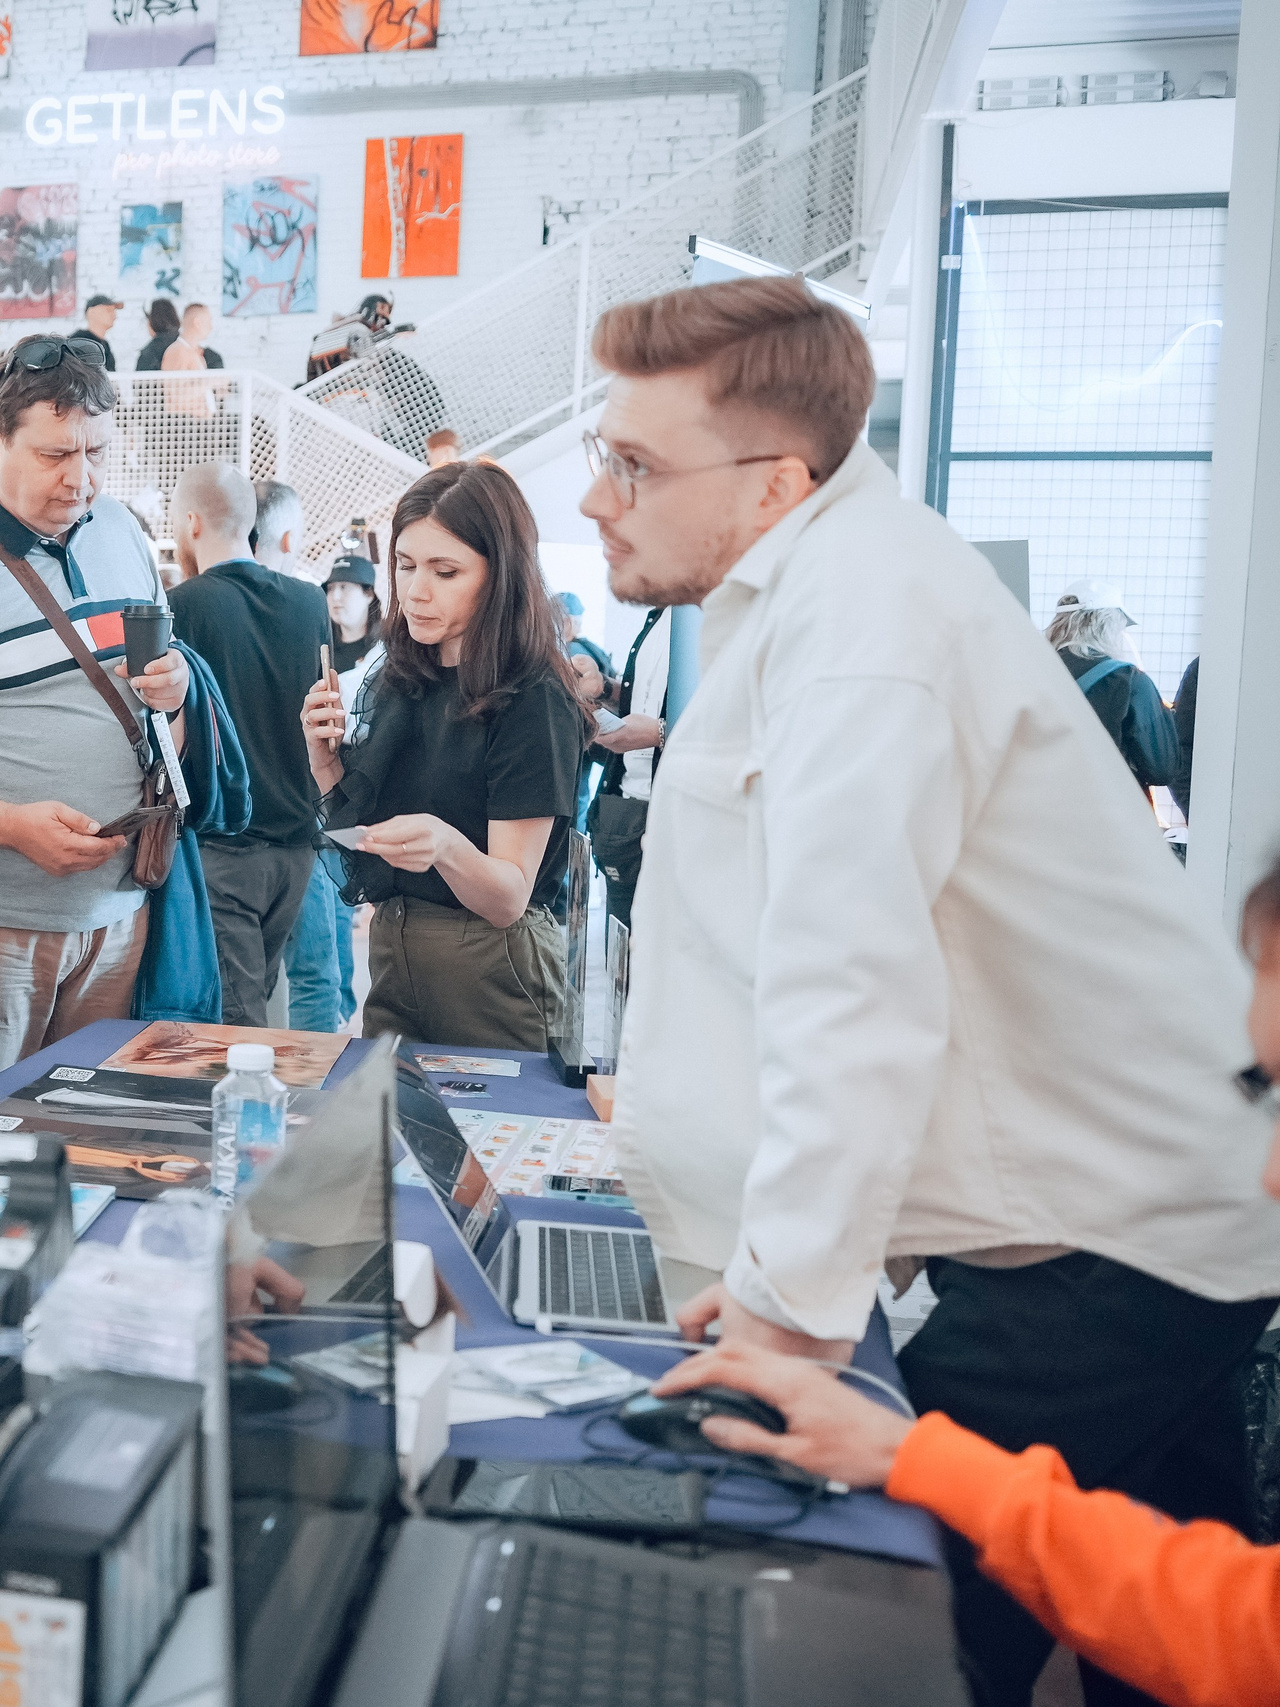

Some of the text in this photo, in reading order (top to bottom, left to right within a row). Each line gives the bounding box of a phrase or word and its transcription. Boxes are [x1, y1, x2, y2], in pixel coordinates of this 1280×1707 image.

[25, 85, 286, 146] GETLENS
[155, 139, 222, 181] photo
[224, 141, 281, 168] store
